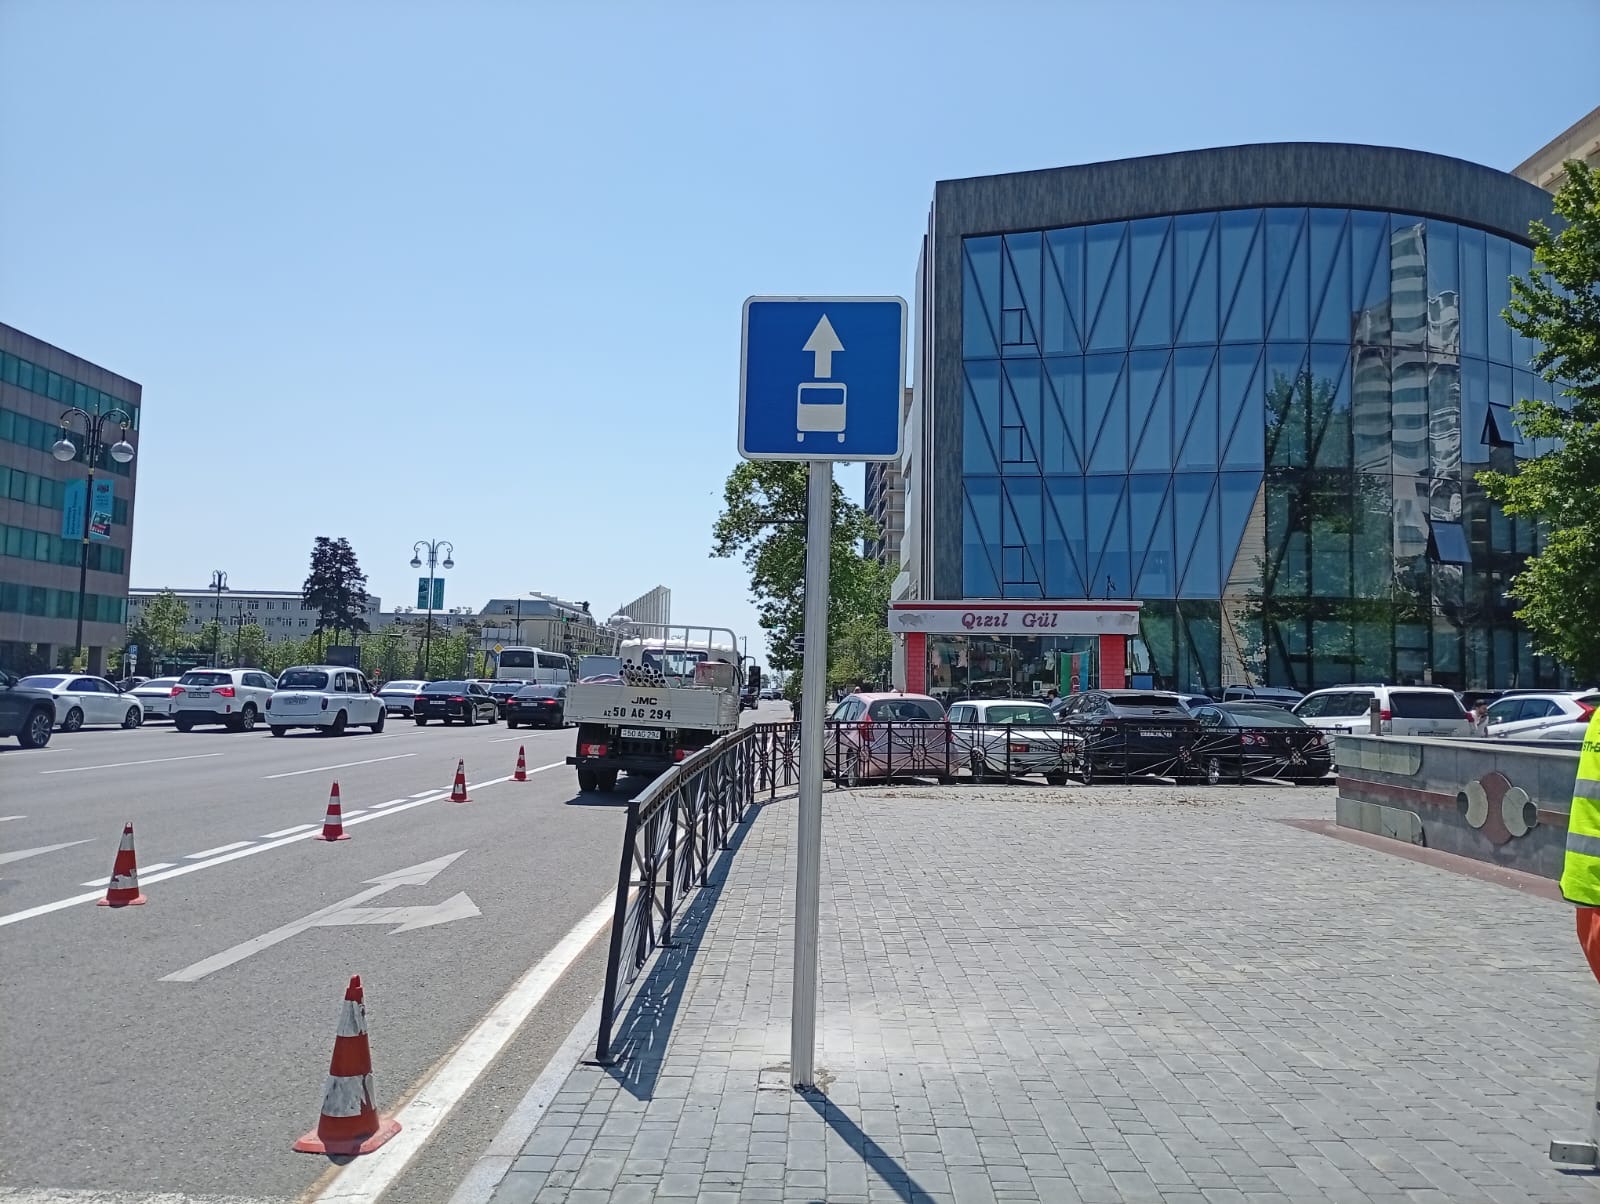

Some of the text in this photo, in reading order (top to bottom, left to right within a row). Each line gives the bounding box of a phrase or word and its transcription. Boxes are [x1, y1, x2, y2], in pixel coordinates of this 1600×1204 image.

[961, 612, 1058, 630] Qızıl Gül
[631, 696, 658, 705] JMC
[613, 706, 627, 717] 50
[631, 708, 645, 718] AG
[649, 709, 672, 720] 294
